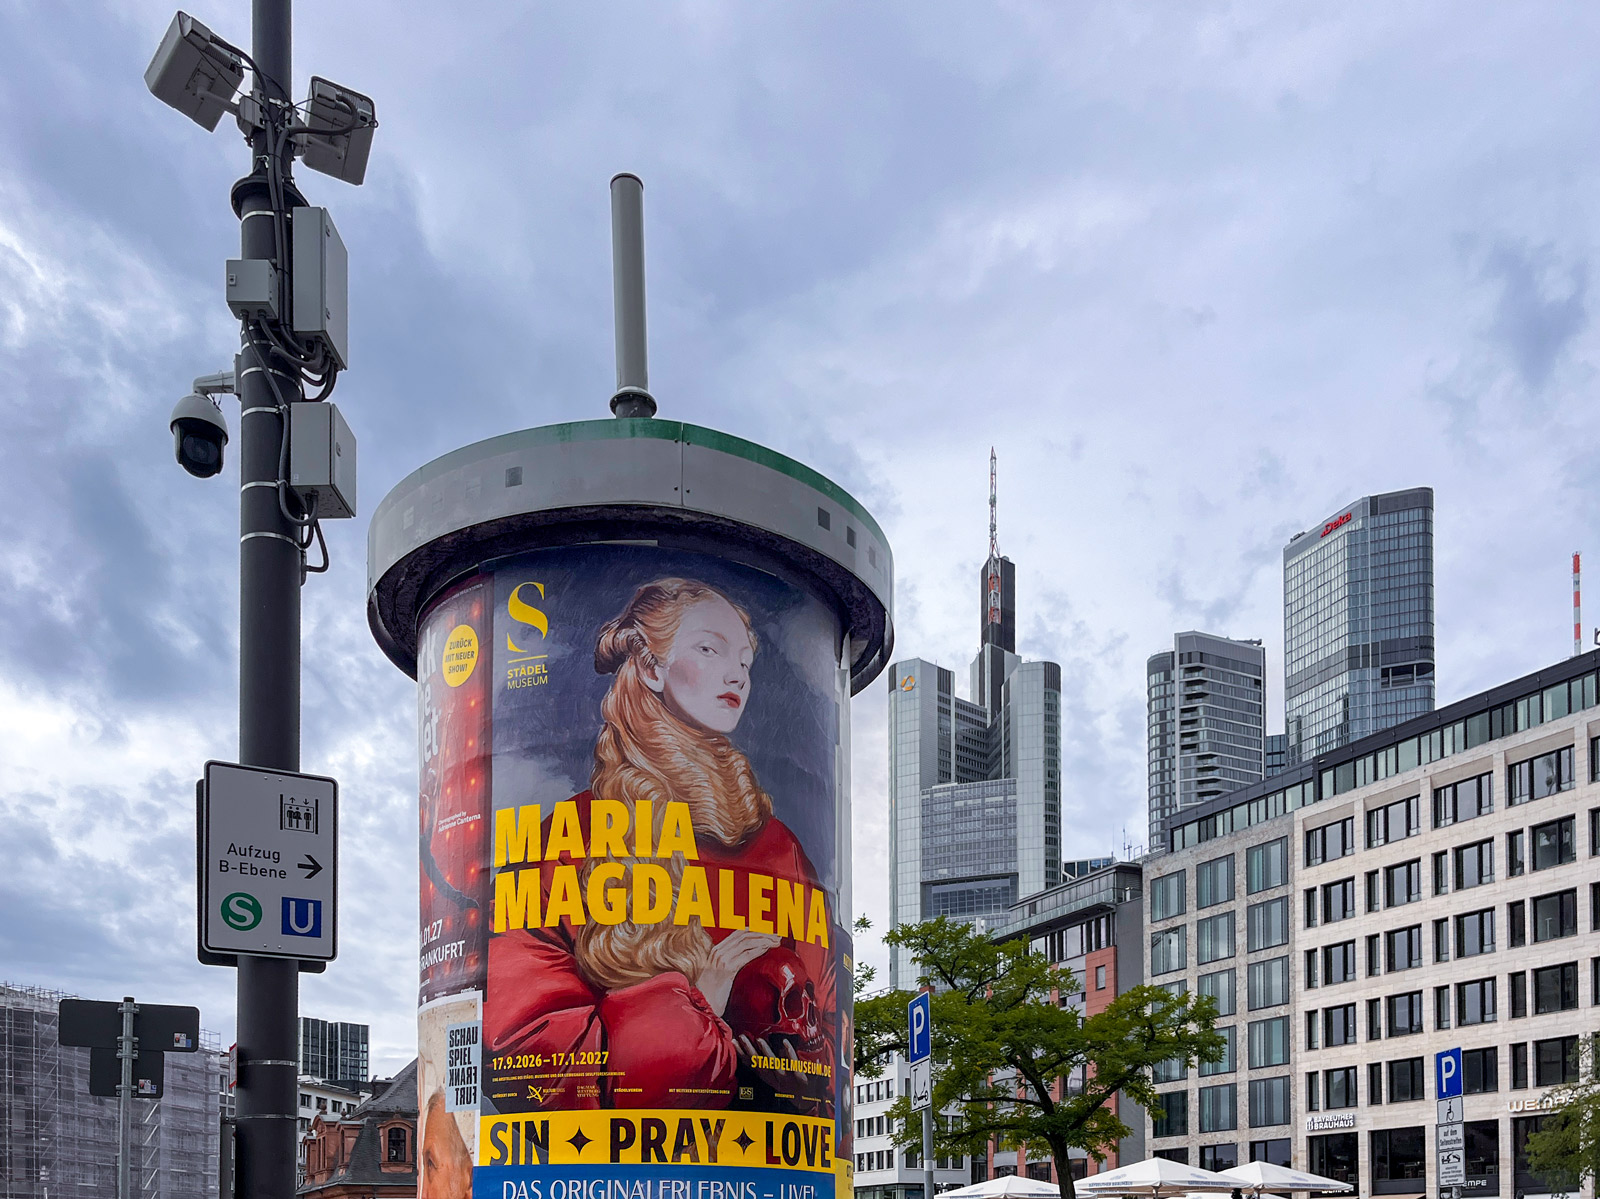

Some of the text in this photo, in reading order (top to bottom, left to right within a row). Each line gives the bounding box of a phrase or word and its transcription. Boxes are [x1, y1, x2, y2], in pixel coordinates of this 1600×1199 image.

[1321, 511, 1352, 537] Deka
[449, 637, 473, 651] ZURÜCK
[445, 650, 475, 663] MIT NEUER
[448, 663, 468, 674] SHOW!
[507, 664, 548, 679] STÄDEL
[507, 675, 548, 690] MUSEUM
[494, 799, 699, 868] MARIA
[227, 842, 280, 864] Aufzug
[219, 860, 287, 879] B-Ebene
[228, 896, 314, 934] S U
[494, 862, 829, 949] MAGDALENA
[449, 1026, 478, 1048] SCHAU
[913, 1005, 925, 1054] P
[449, 1047, 472, 1067] SPIEL
[751, 1055, 831, 1078] STAEDELMUSEUM.DE
[1441, 1055, 1456, 1093] P
[1313, 1113, 1354, 1123] BAYREUTHER
[1313, 1120, 1354, 1130] BRAUHAUS
[489, 1117, 831, 1168] SIN PRAY LOVE
[503, 1180, 542, 1199] DAS
